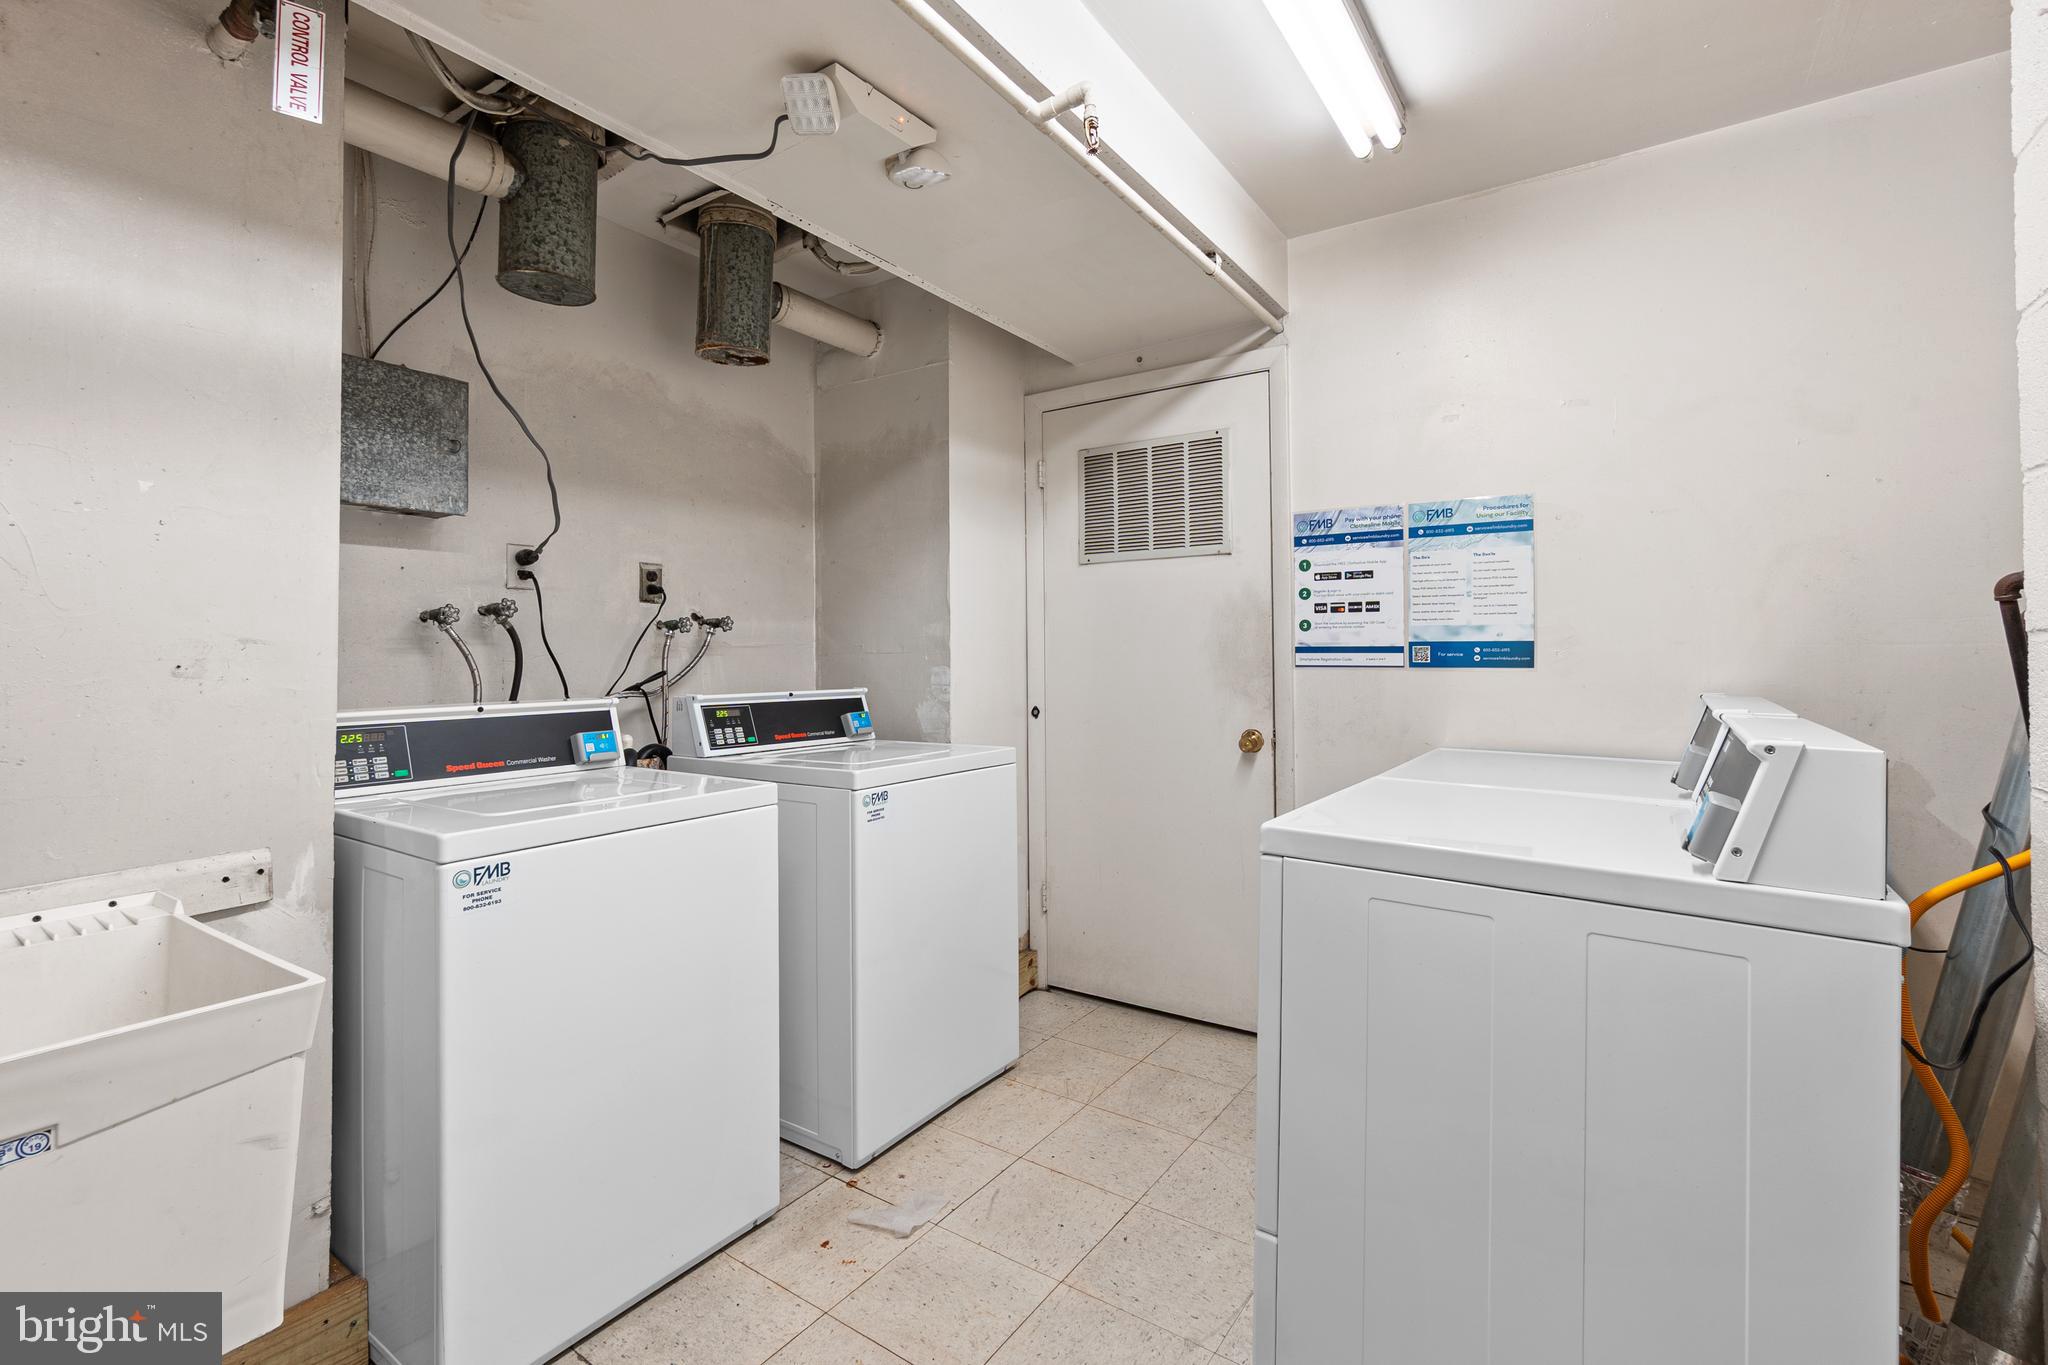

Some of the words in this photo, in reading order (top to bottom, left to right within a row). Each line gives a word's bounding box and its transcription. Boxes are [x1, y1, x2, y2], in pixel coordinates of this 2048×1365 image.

[290, 12, 311, 67] CONTROL
[289, 73, 308, 112] VALVE
[1426, 508, 1454, 522] FMB
[1309, 519, 1333, 532] FMB
[340, 734, 363, 744] 2.25
[446, 762, 475, 773] Speed
[476, 760, 505, 770] Queen
[506, 757, 537, 766] Commercial
[538, 755, 557, 763] Washer
[871, 790, 889, 806] FMB
[474, 861, 511, 886] FMB
[472, 895, 493, 903] PHONE
[476, 887, 502, 897] SERVICE
[29, 1143, 42, 1152] 19
